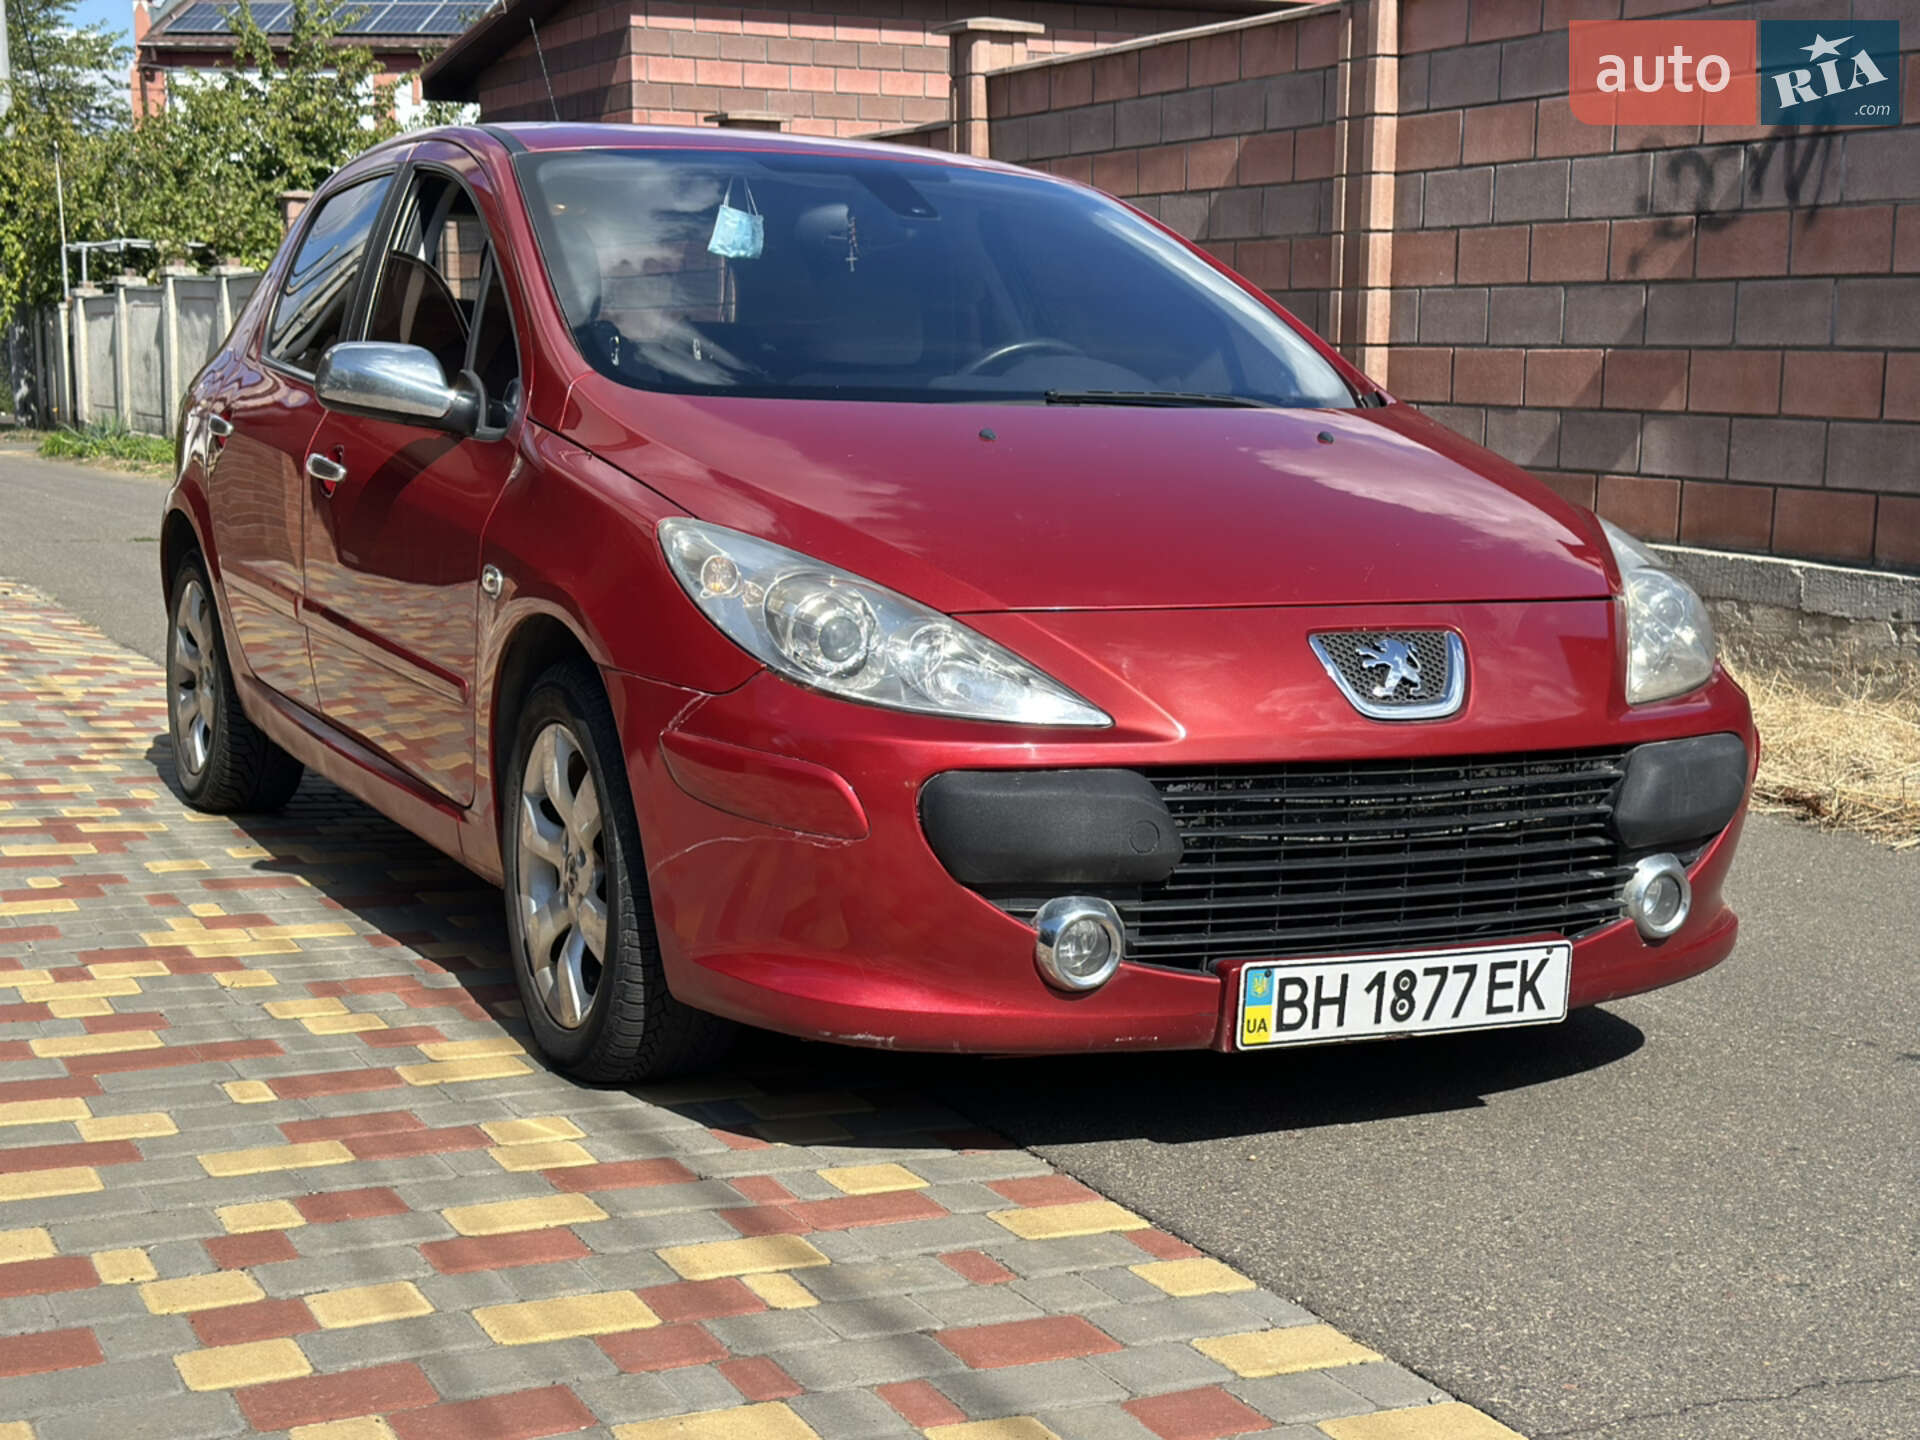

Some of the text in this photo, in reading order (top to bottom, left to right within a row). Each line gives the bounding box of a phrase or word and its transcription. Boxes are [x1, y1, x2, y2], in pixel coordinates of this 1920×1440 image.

[1276, 957, 1550, 1032] BH 1877 EK
[1246, 1019, 1268, 1034] UA
